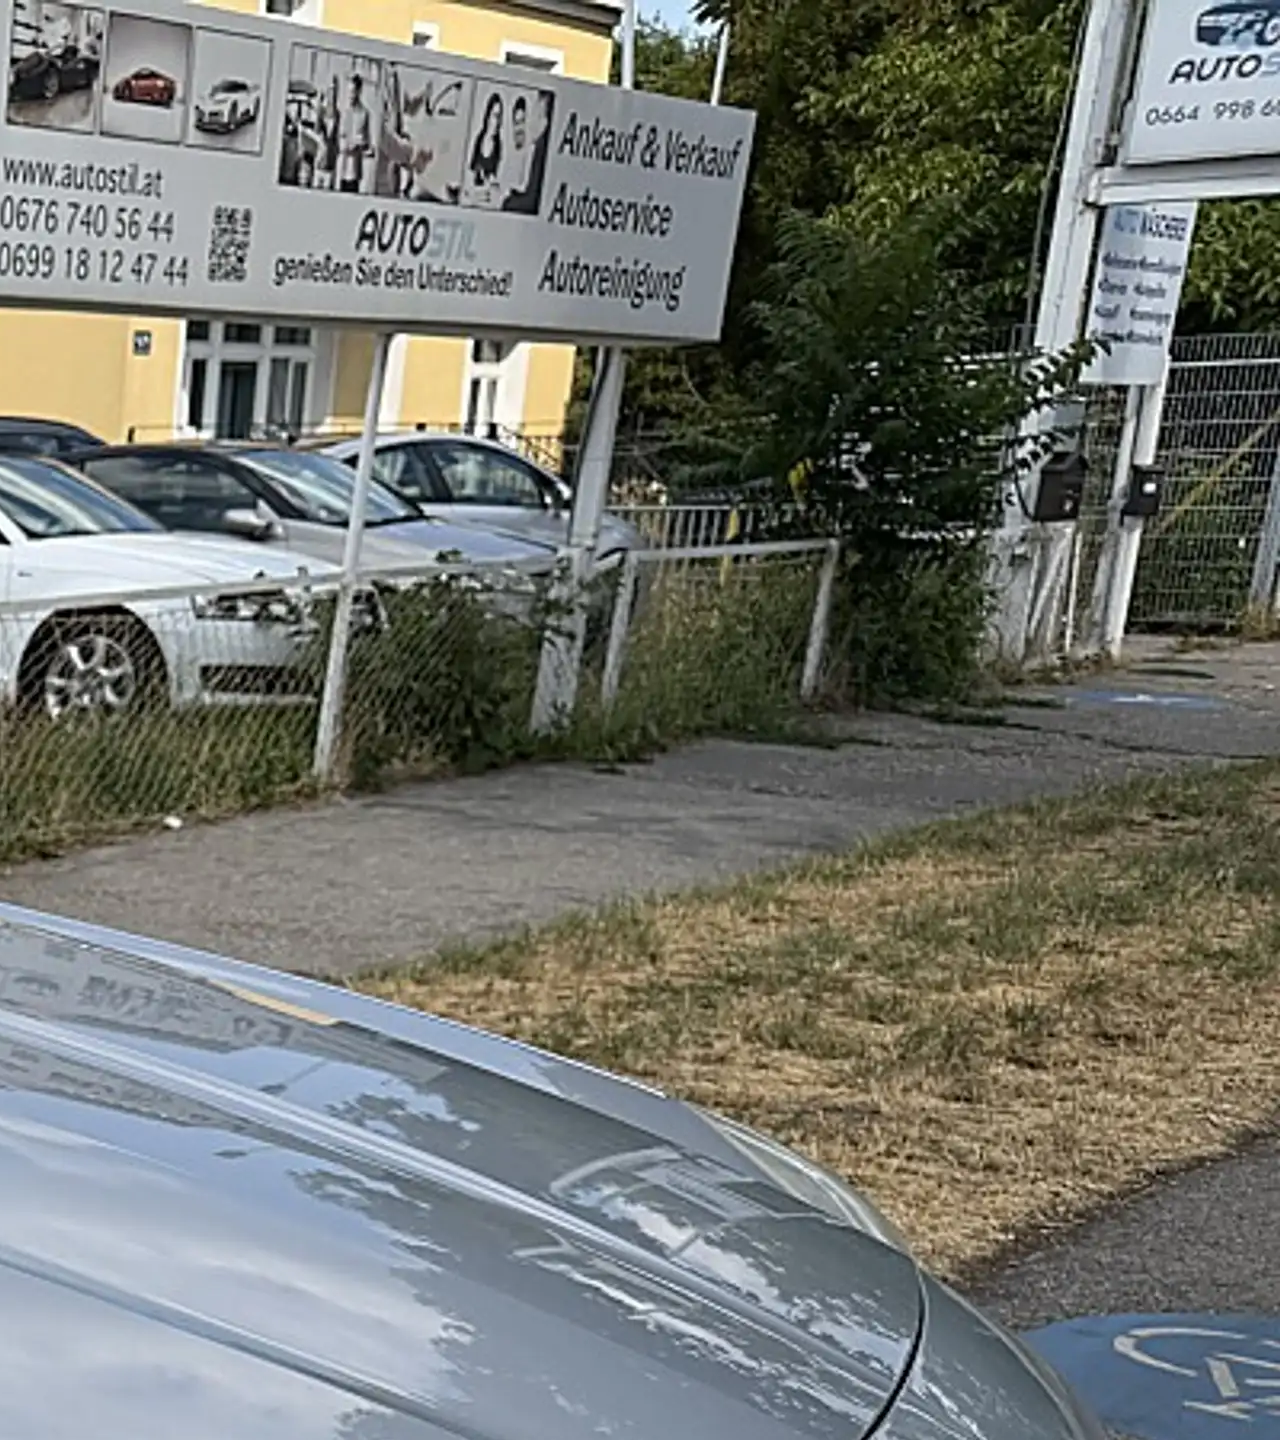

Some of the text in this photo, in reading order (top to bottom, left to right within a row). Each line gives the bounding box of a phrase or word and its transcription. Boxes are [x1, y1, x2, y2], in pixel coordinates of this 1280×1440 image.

[1145, 105, 1201, 126] 0664
[1213, 100, 1256, 120] 998
[558, 112, 744, 179] Ankauf & Verkauf
[2, 157, 164, 199] www.autostil.at
[0, 195, 176, 244] 0676 740 56 44
[547, 182, 674, 237] Autoservice
[354, 209, 477, 262] AUTOSTIL
[64, 247, 90, 281] 18
[99, 249, 125, 283] 12
[130, 252, 159, 285] 47
[162, 255, 189, 287] 44
[273, 252, 514, 297] genießen Sie den Unterschied!
[537, 249, 688, 312] Autoreinigung
